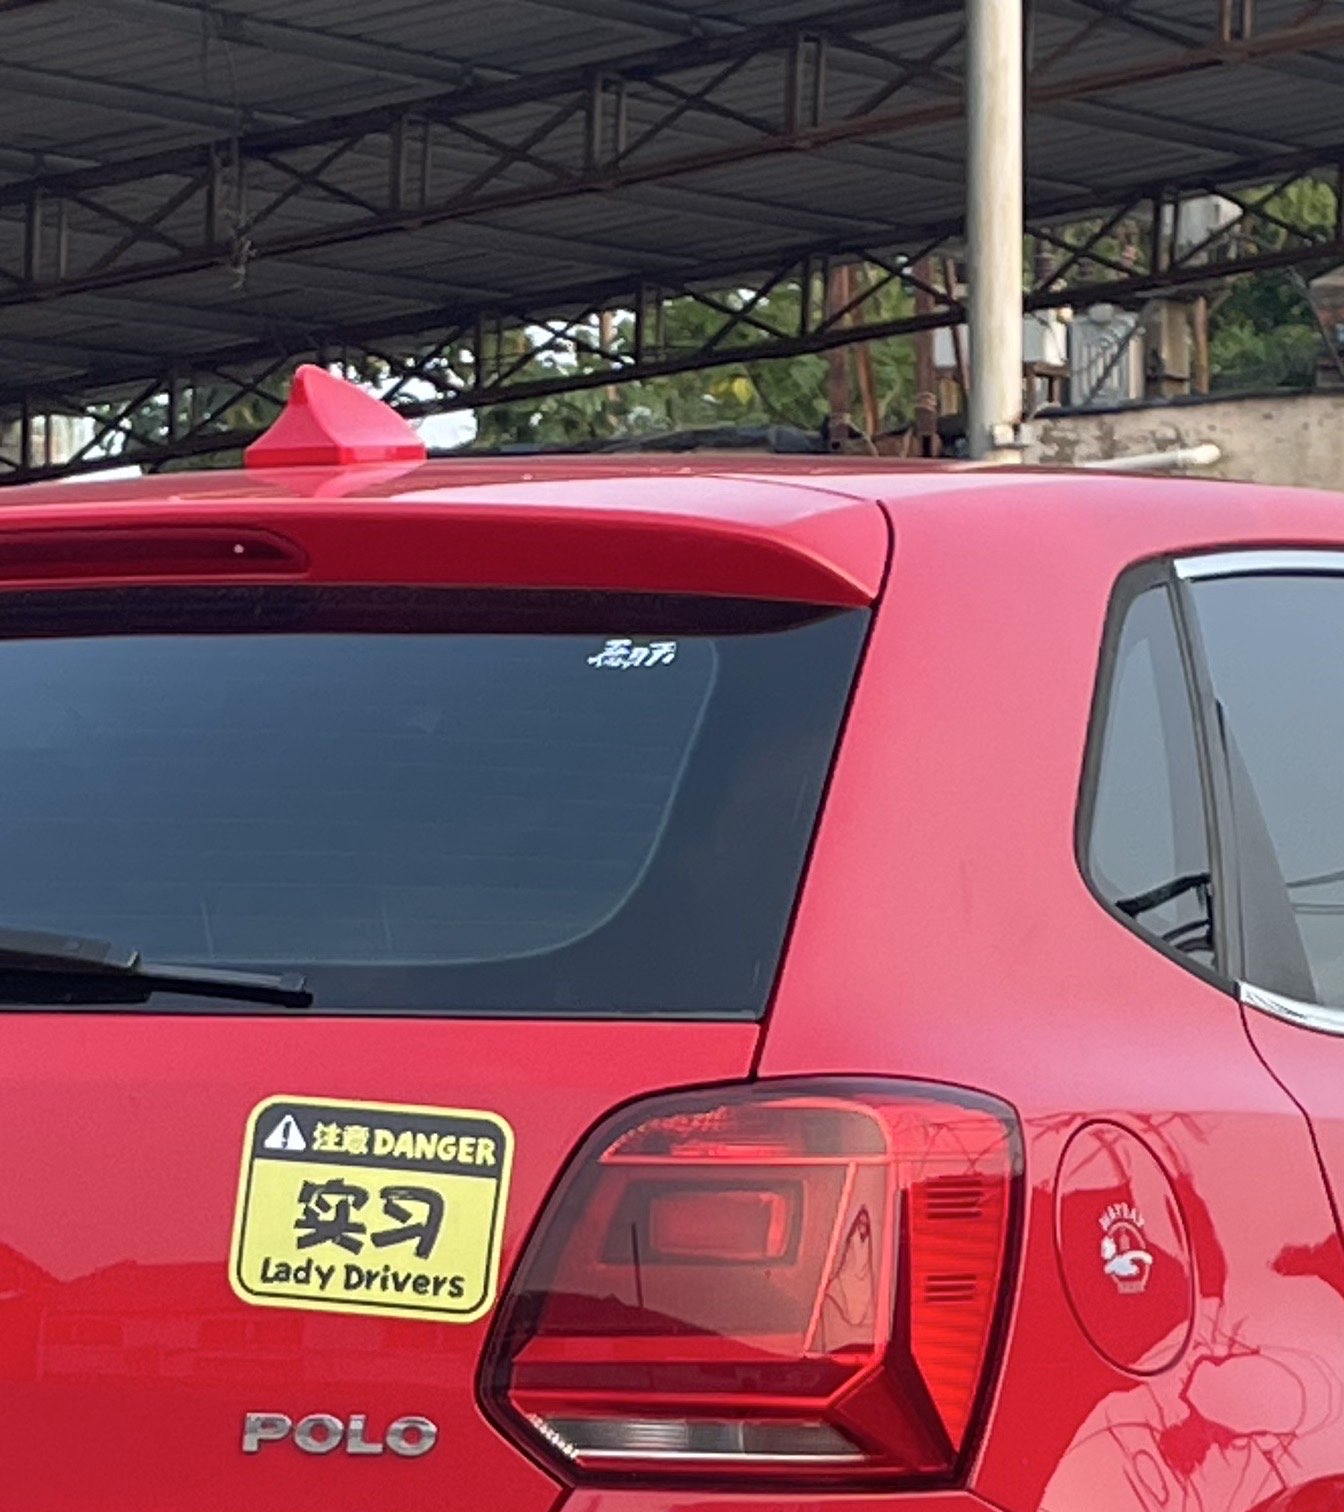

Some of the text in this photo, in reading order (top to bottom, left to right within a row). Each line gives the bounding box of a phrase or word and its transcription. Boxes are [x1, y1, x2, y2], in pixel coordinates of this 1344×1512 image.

[311, 1121, 497, 1167] 注意 DANGER
[293, 1178, 445, 1261] 实习
[260, 1257, 466, 1299] Lady Drivers
[242, 1411, 438, 1457] POLO
